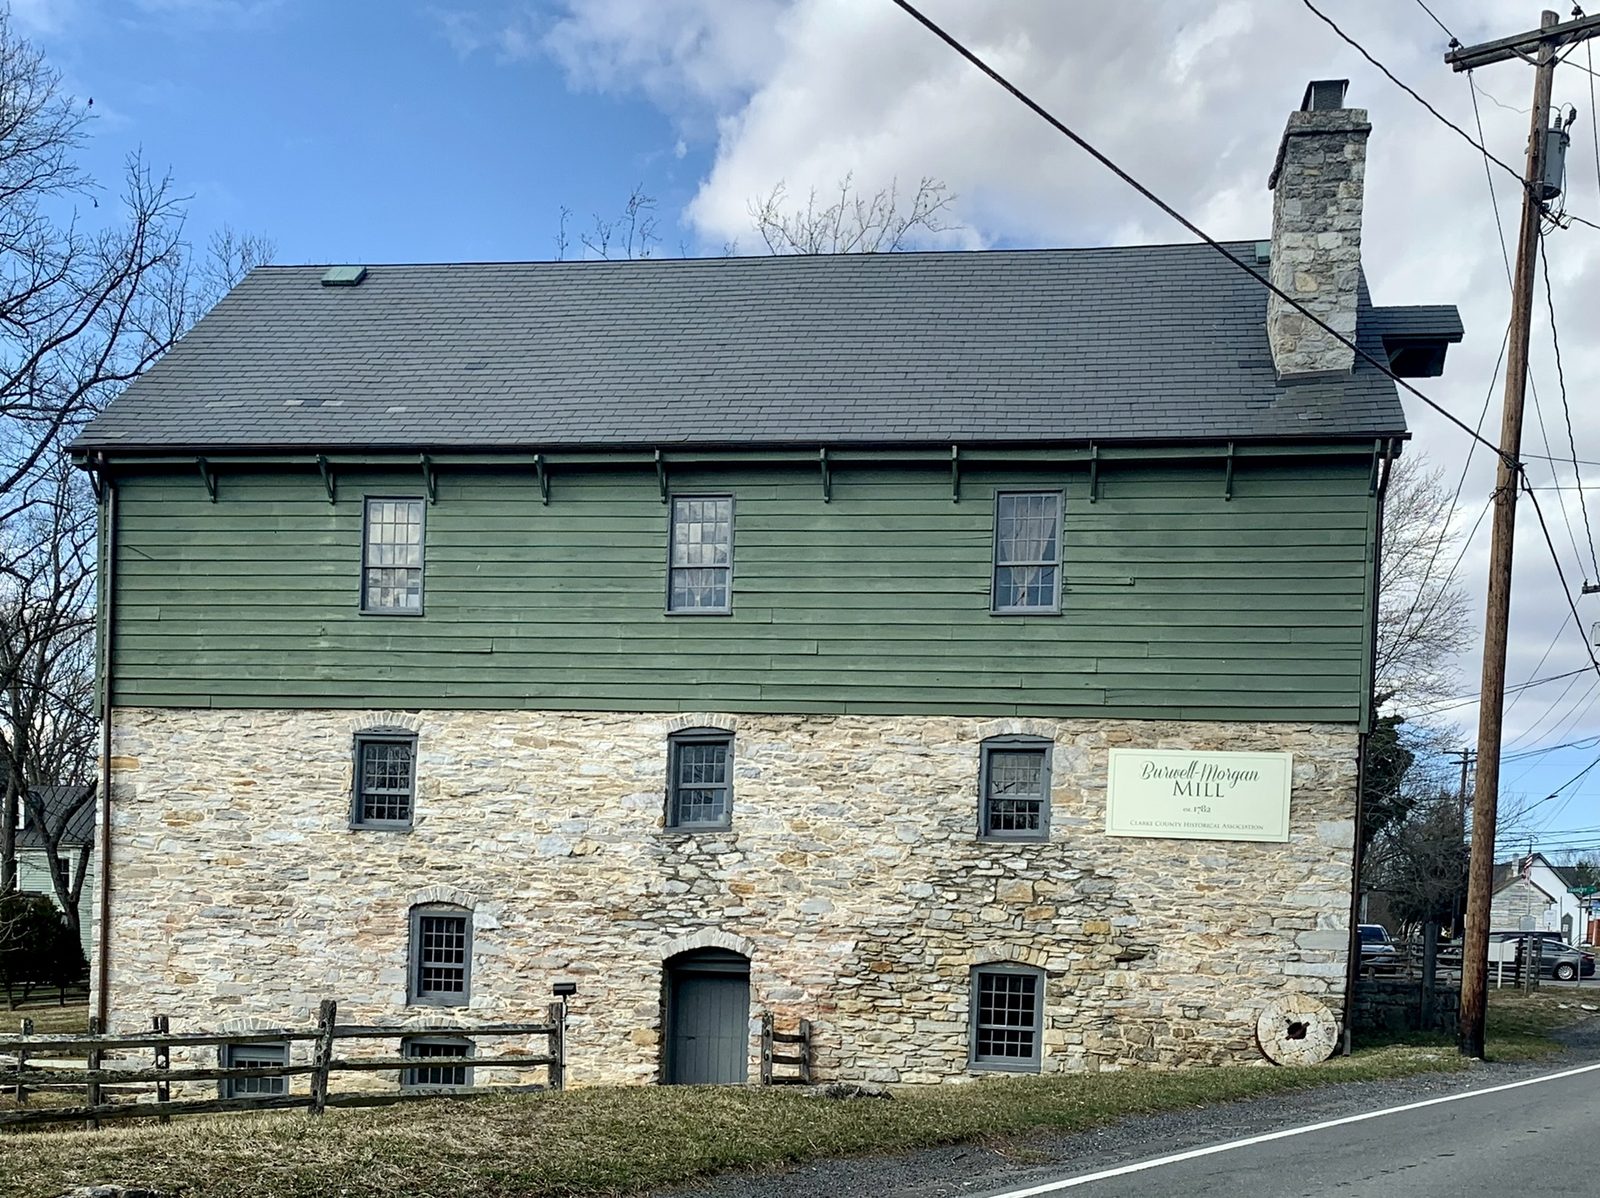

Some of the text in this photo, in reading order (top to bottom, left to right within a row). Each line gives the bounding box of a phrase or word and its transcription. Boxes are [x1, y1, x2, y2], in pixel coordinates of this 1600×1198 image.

[1140, 760, 1260, 789] Burwell-Morgan
[1172, 780, 1225, 798] MILL
[1193, 804, 1211, 815] 1782
[1154, 820, 1181, 828] COUNTY
[1222, 823, 1264, 831] ASSOCIATION
